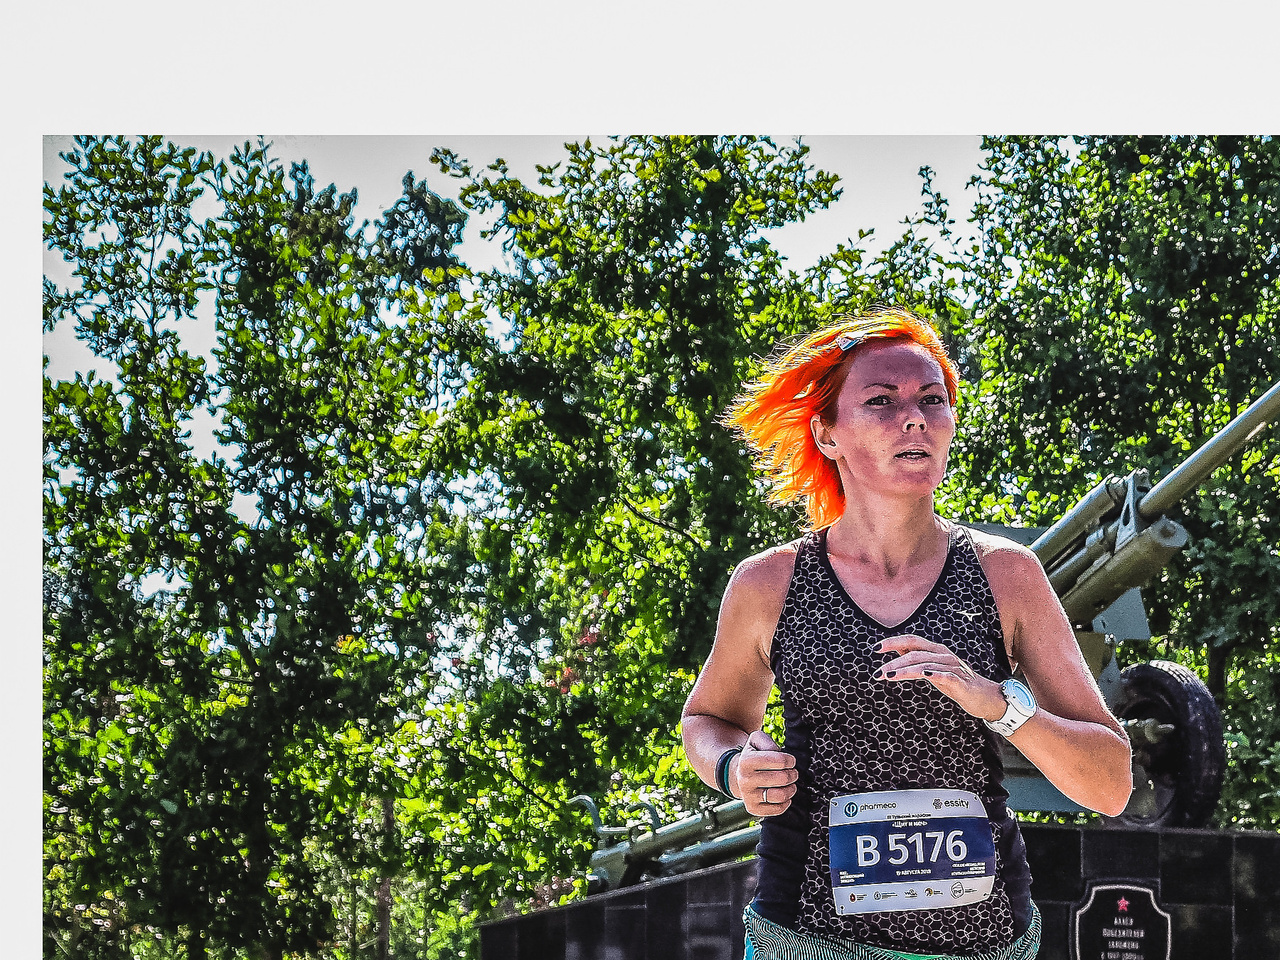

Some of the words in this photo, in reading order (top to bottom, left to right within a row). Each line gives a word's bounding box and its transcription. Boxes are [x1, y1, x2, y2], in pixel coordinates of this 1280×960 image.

[859, 801, 897, 813] pharmeco
[944, 798, 969, 809] essity
[856, 834, 881, 867] B
[888, 830, 968, 866] 5176
